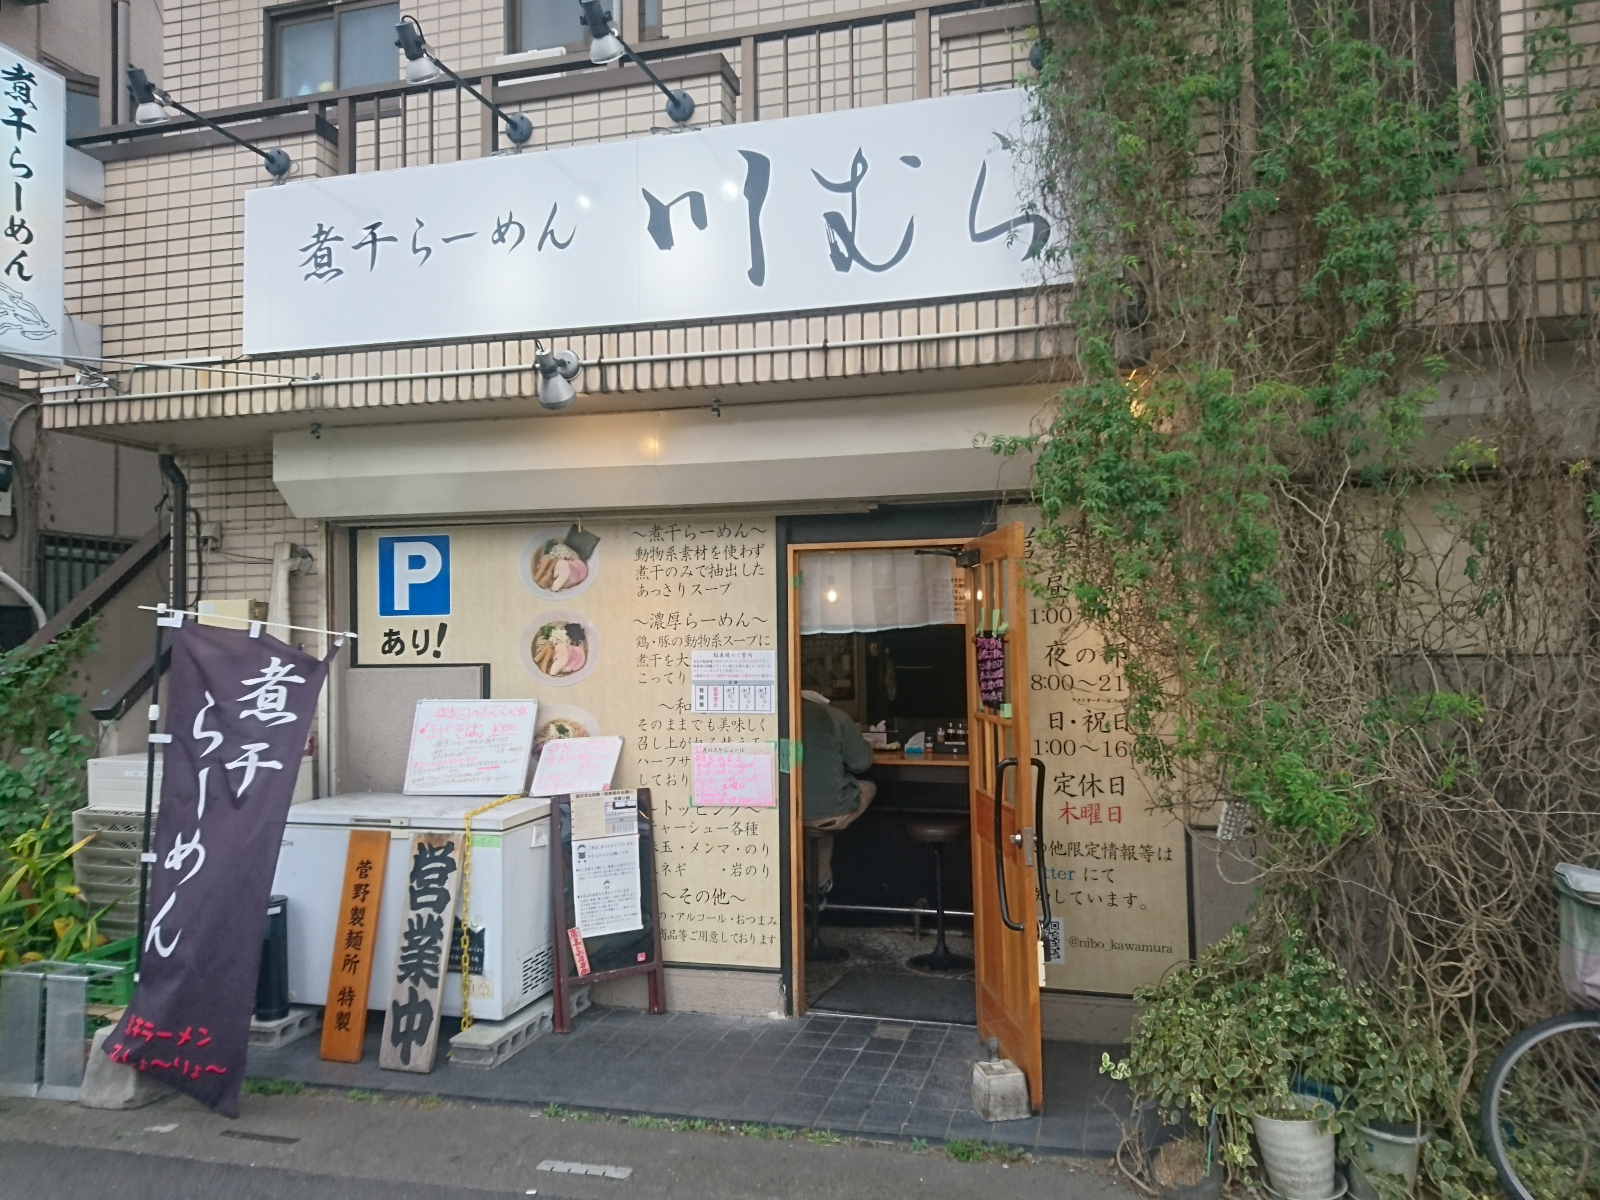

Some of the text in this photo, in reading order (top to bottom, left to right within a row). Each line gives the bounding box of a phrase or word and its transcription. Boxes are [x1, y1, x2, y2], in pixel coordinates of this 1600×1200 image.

[1, 63, 38, 282] 煮干らーめん
[298, 131, 1052, 287] 煮干らーめん 川むら
[632, 522, 767, 542] 〜煮干らーめん〜
[635, 543, 765, 562] 動物系素材を使わず
[393, 541, 443, 611] P
[636, 562, 765, 580] 煮干のみで抽出した
[637, 582, 732, 598] あっさりスープ
[633, 611, 768, 631] 〜濃厚らーめん〜
[636, 633, 771, 649] 鶏・豚の動物系スープに
[638, 671, 686, 685] こってり
[225, 657, 306, 798] 煮干
[638, 717, 765, 732] そのままでも美味しく
[1053, 771, 1125, 798] 定休日
[1058, 801, 1122, 825] 木曜日
[144, 690, 224, 959] らーめん
[1083, 867, 1115, 883] にて
[660, 888, 747, 906] 〜その他〜
[334, 859, 373, 1032] 菅野製麺所 特製
[391, 840, 458, 1066] 営業中
[1069, 936, 1173, 954] @nibo_kawamura
